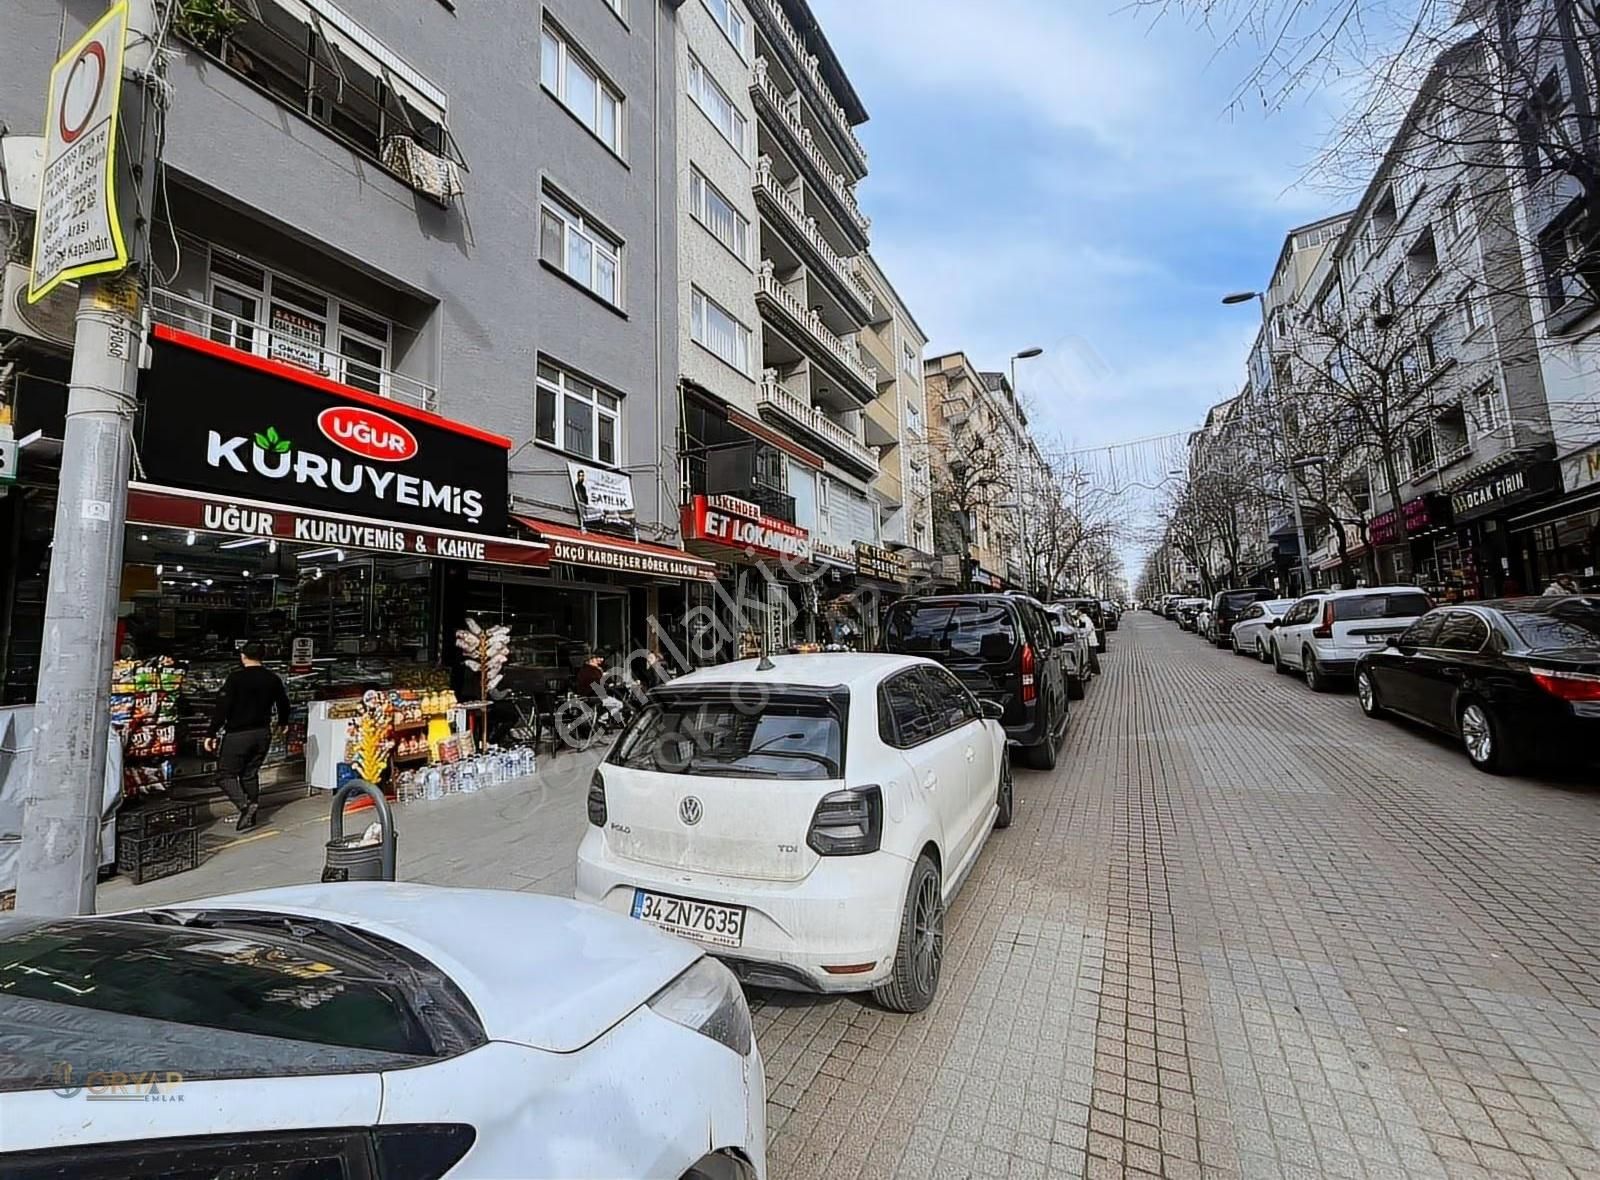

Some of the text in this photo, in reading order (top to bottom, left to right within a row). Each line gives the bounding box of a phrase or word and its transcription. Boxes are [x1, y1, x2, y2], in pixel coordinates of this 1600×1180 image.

[333, 416, 407, 454] UĞUR
[207, 429, 483, 524] KURUYEMİŞ
[591, 492, 628, 508] SATILIK
[203, 505, 485, 560] UĞUR KURUYEMİŞ & KAHVE
[705, 511, 730, 537] ET
[554, 542, 585, 561] ÖKÇÜ
[587, 550, 641, 569] KARDEŞLER
[642, 556, 669, 573] BÖREK
